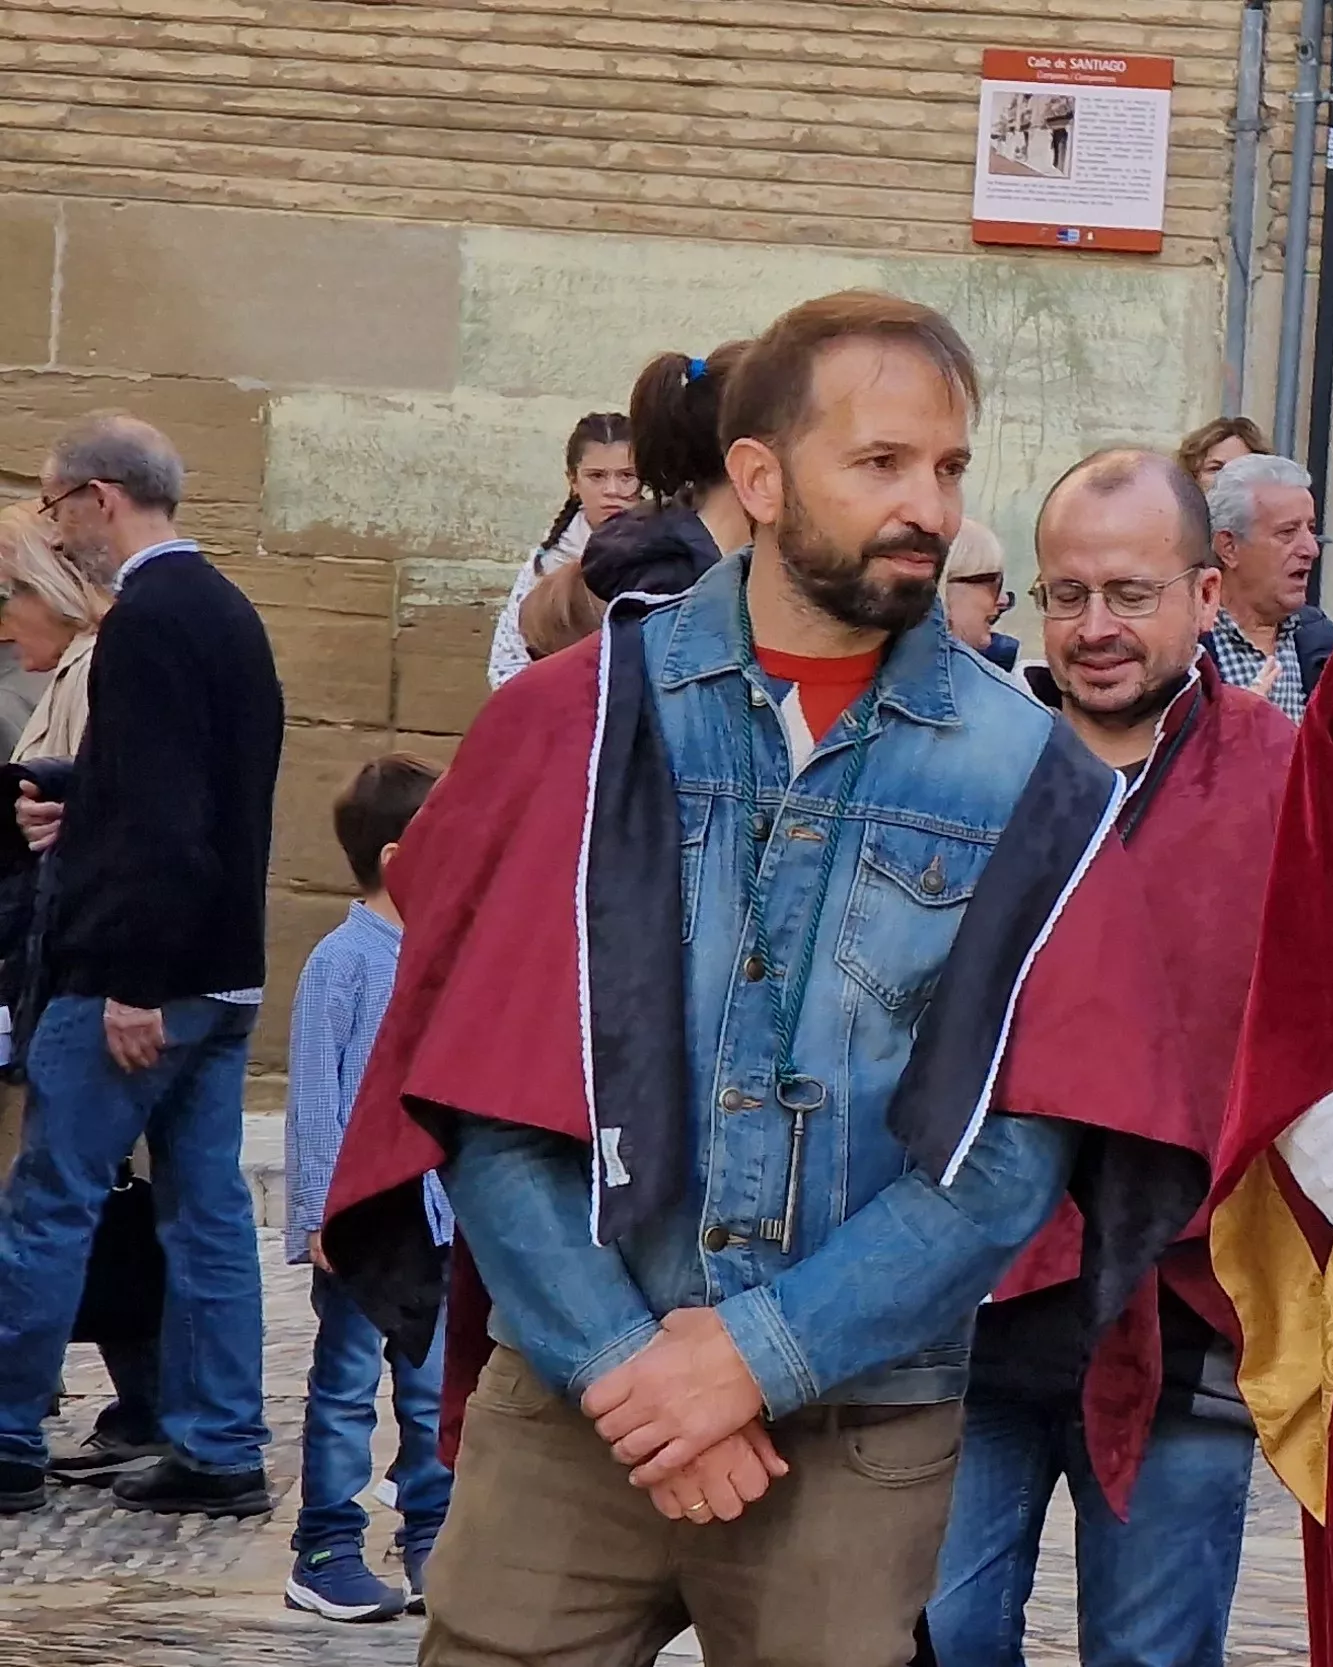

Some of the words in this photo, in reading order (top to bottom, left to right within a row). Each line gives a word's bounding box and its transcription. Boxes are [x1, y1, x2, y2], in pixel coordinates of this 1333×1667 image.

[1027, 56, 1052, 68] Calle
[1054, 58, 1067, 69] de
[1069, 58, 1127, 72] SANTIAGO
